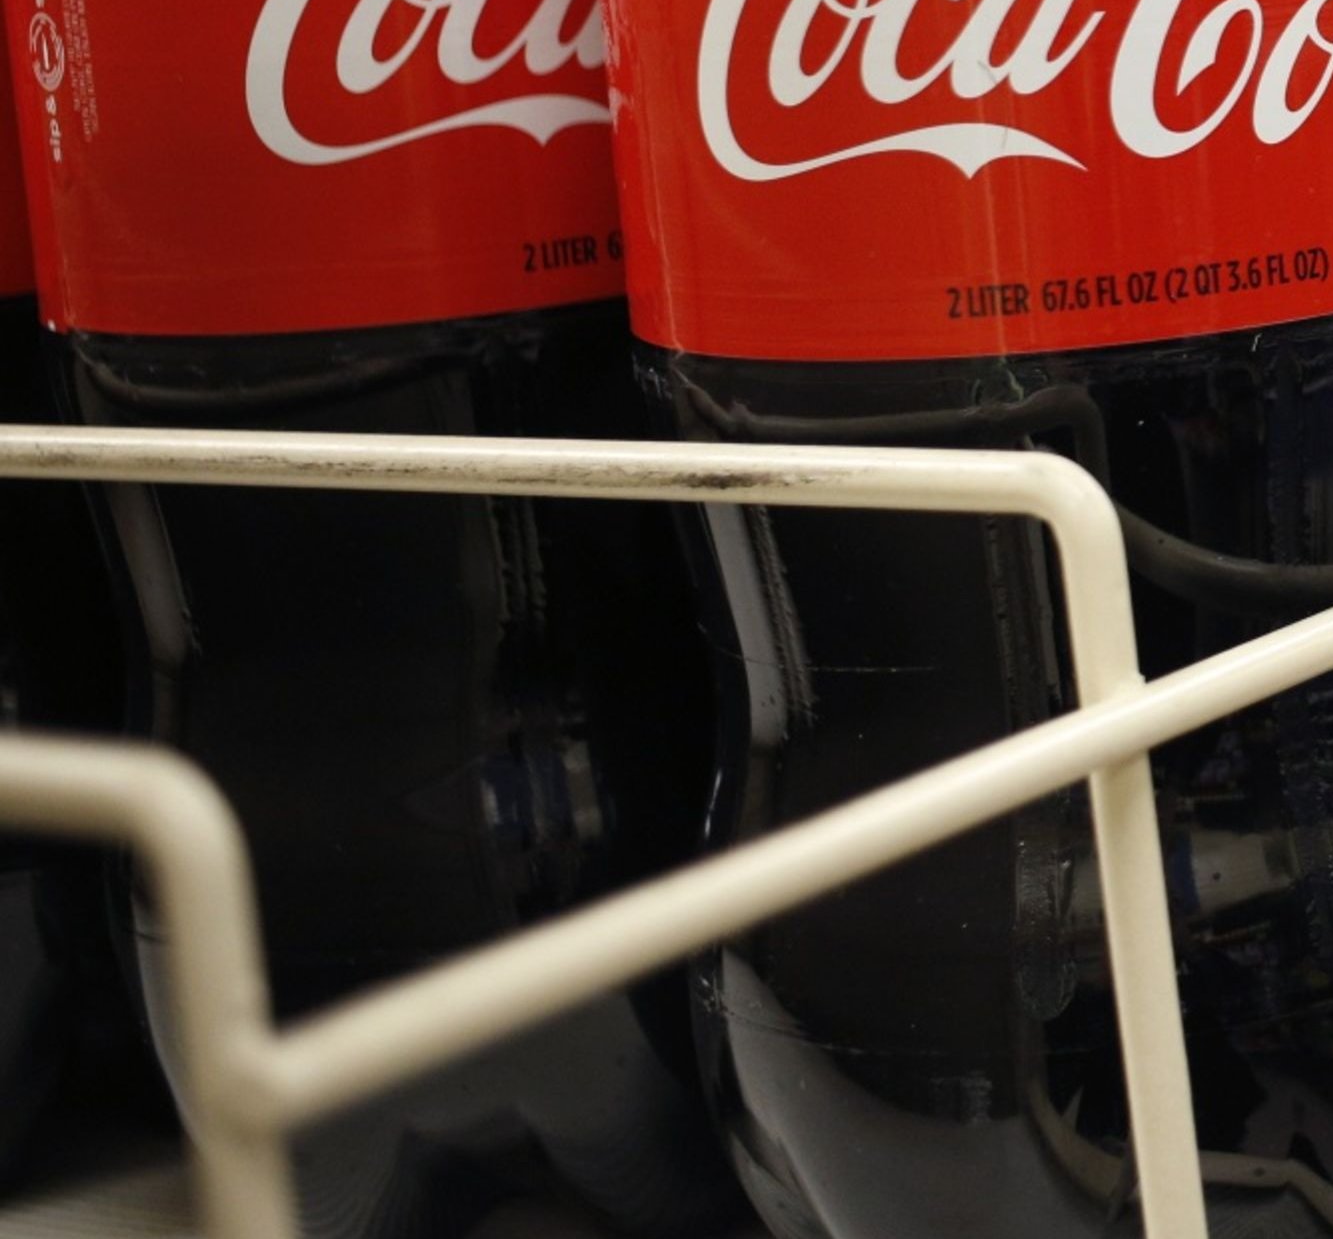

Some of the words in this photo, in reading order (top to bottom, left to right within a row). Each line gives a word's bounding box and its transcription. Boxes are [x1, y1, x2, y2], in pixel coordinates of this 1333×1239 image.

[523, 242, 537, 274] 2
[541, 235, 599, 271] LITER
[946, 287, 963, 319] 2
[967, 282, 1030, 318] LITER
[1041, 277, 1091, 313] 67.6
[1096, 274, 1122, 308] FL
[1128, 271, 1158, 304] OZ
[1165, 267, 1190, 303] (2
[1194, 262, 1222, 296] QT
[1227, 257, 1263, 292] 3.6
[1266, 253, 1291, 286] FL
[1294, 246, 1330, 283] OZ)
